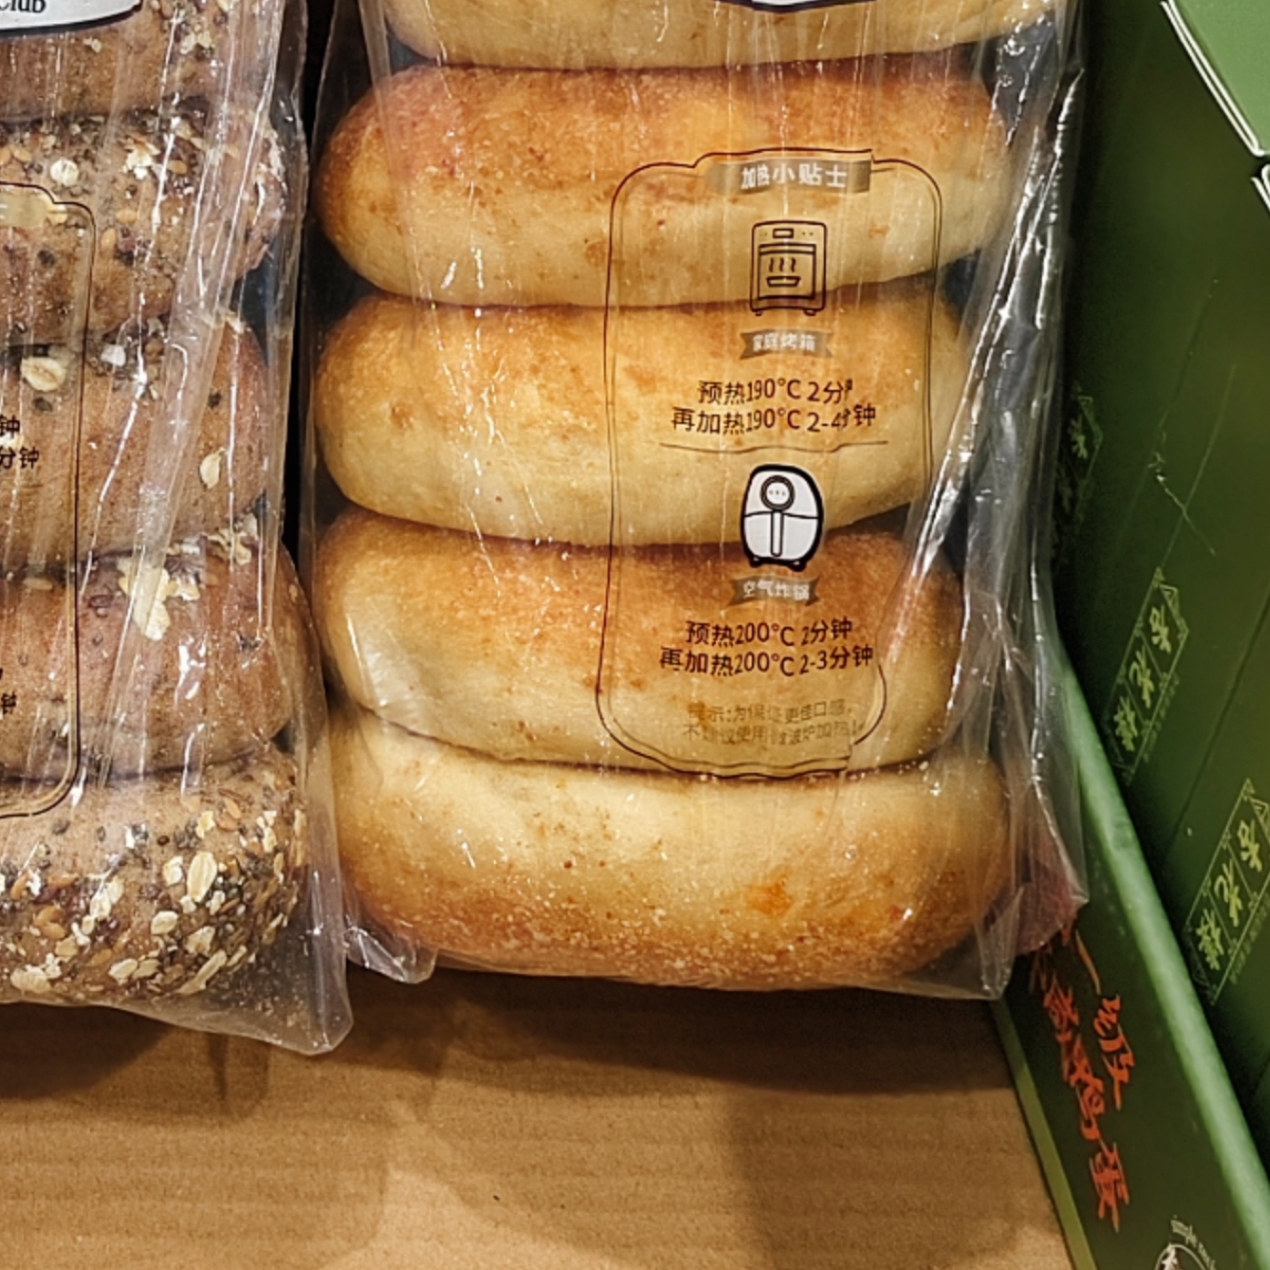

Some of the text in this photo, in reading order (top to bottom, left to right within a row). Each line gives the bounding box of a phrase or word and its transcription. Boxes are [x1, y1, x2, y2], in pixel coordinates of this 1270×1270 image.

[740, 162, 847, 190] 加热小贴士
